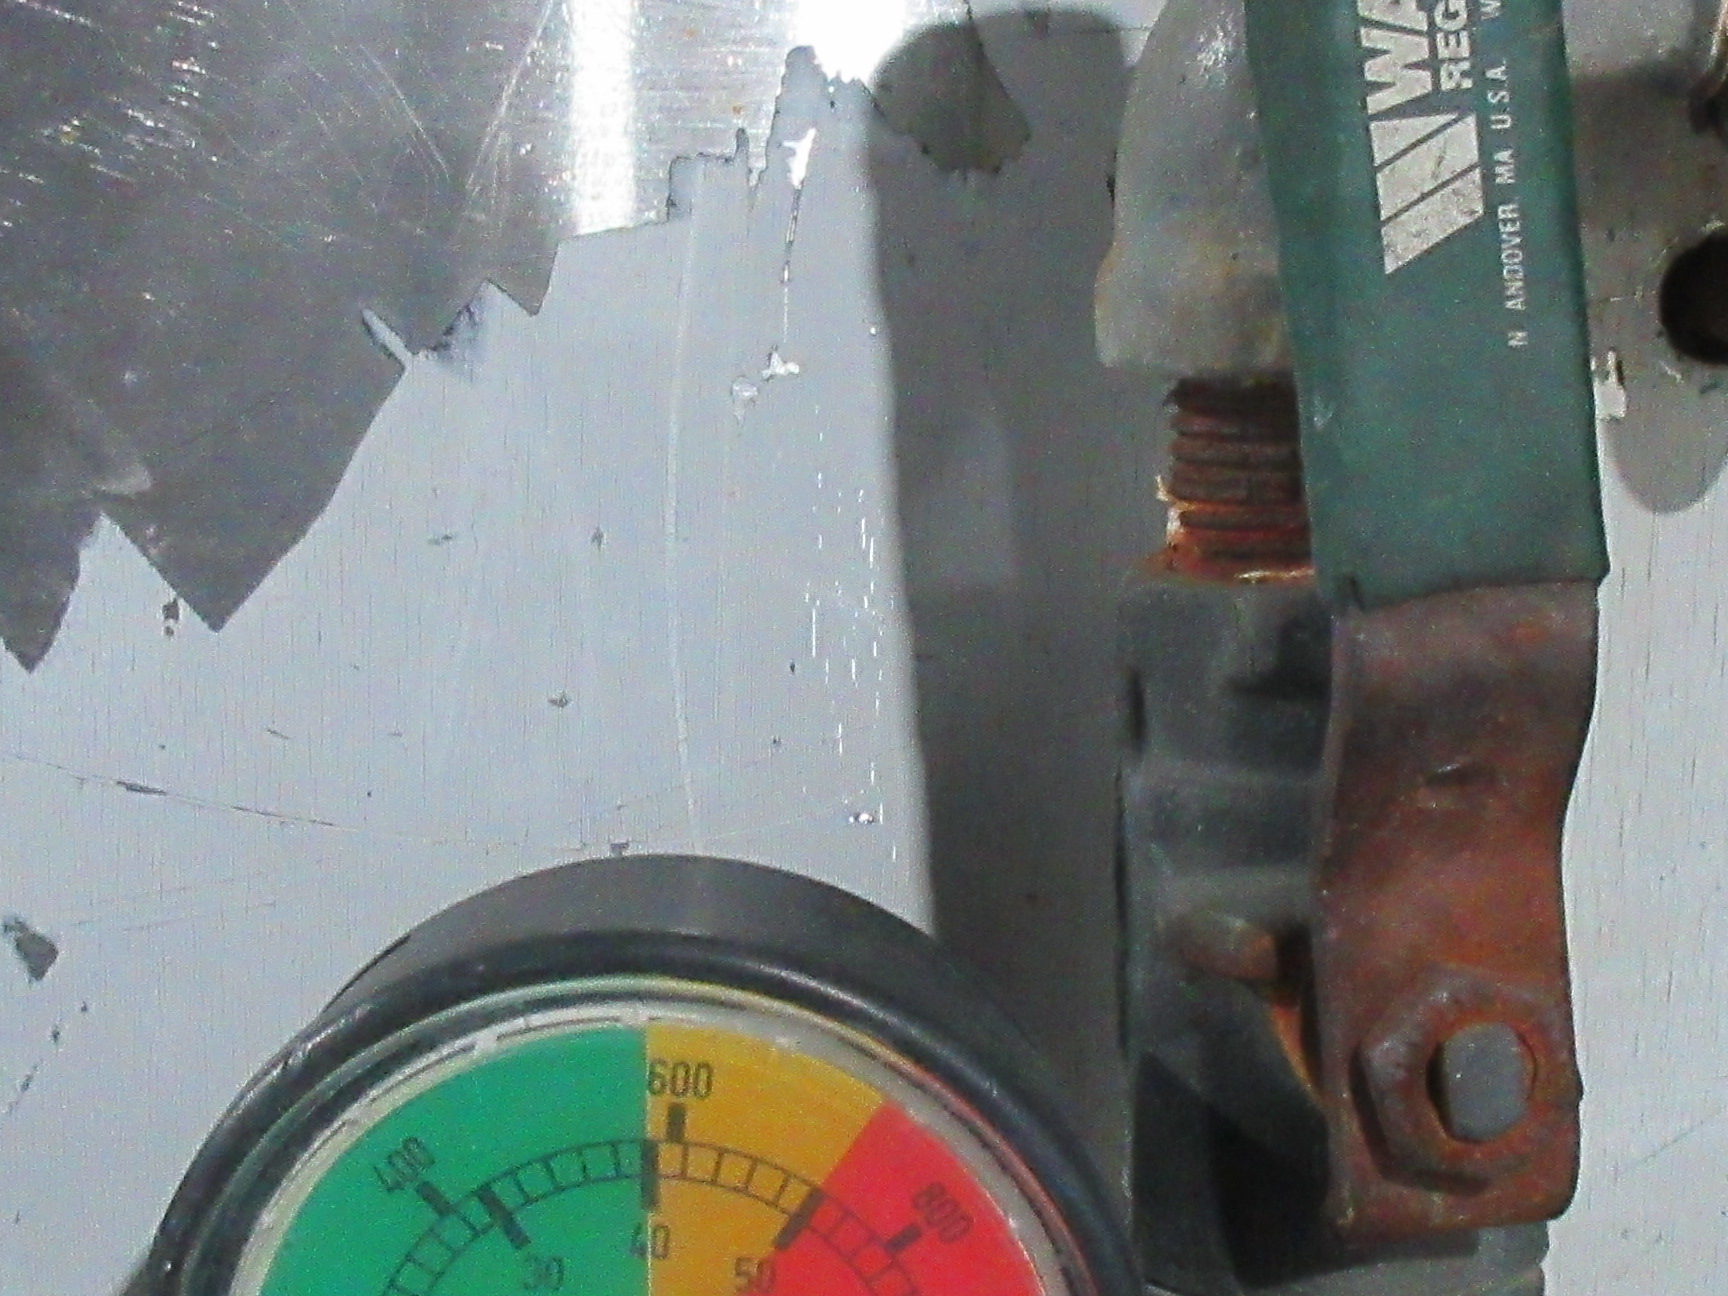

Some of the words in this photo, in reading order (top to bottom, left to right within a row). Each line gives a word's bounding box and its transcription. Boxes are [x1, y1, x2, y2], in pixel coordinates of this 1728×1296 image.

[1493, 148, 1516, 185] MA
[1506, 330, 1529, 348] N
[647, 1057, 714, 1100] 600
[373, 1136, 436, 1194] 400
[911, 1181, 975, 1245] 800
[629, 1221, 671, 1260] 40
[521, 1255, 566, 1293] 30
[734, 1256, 776, 1295] 50
